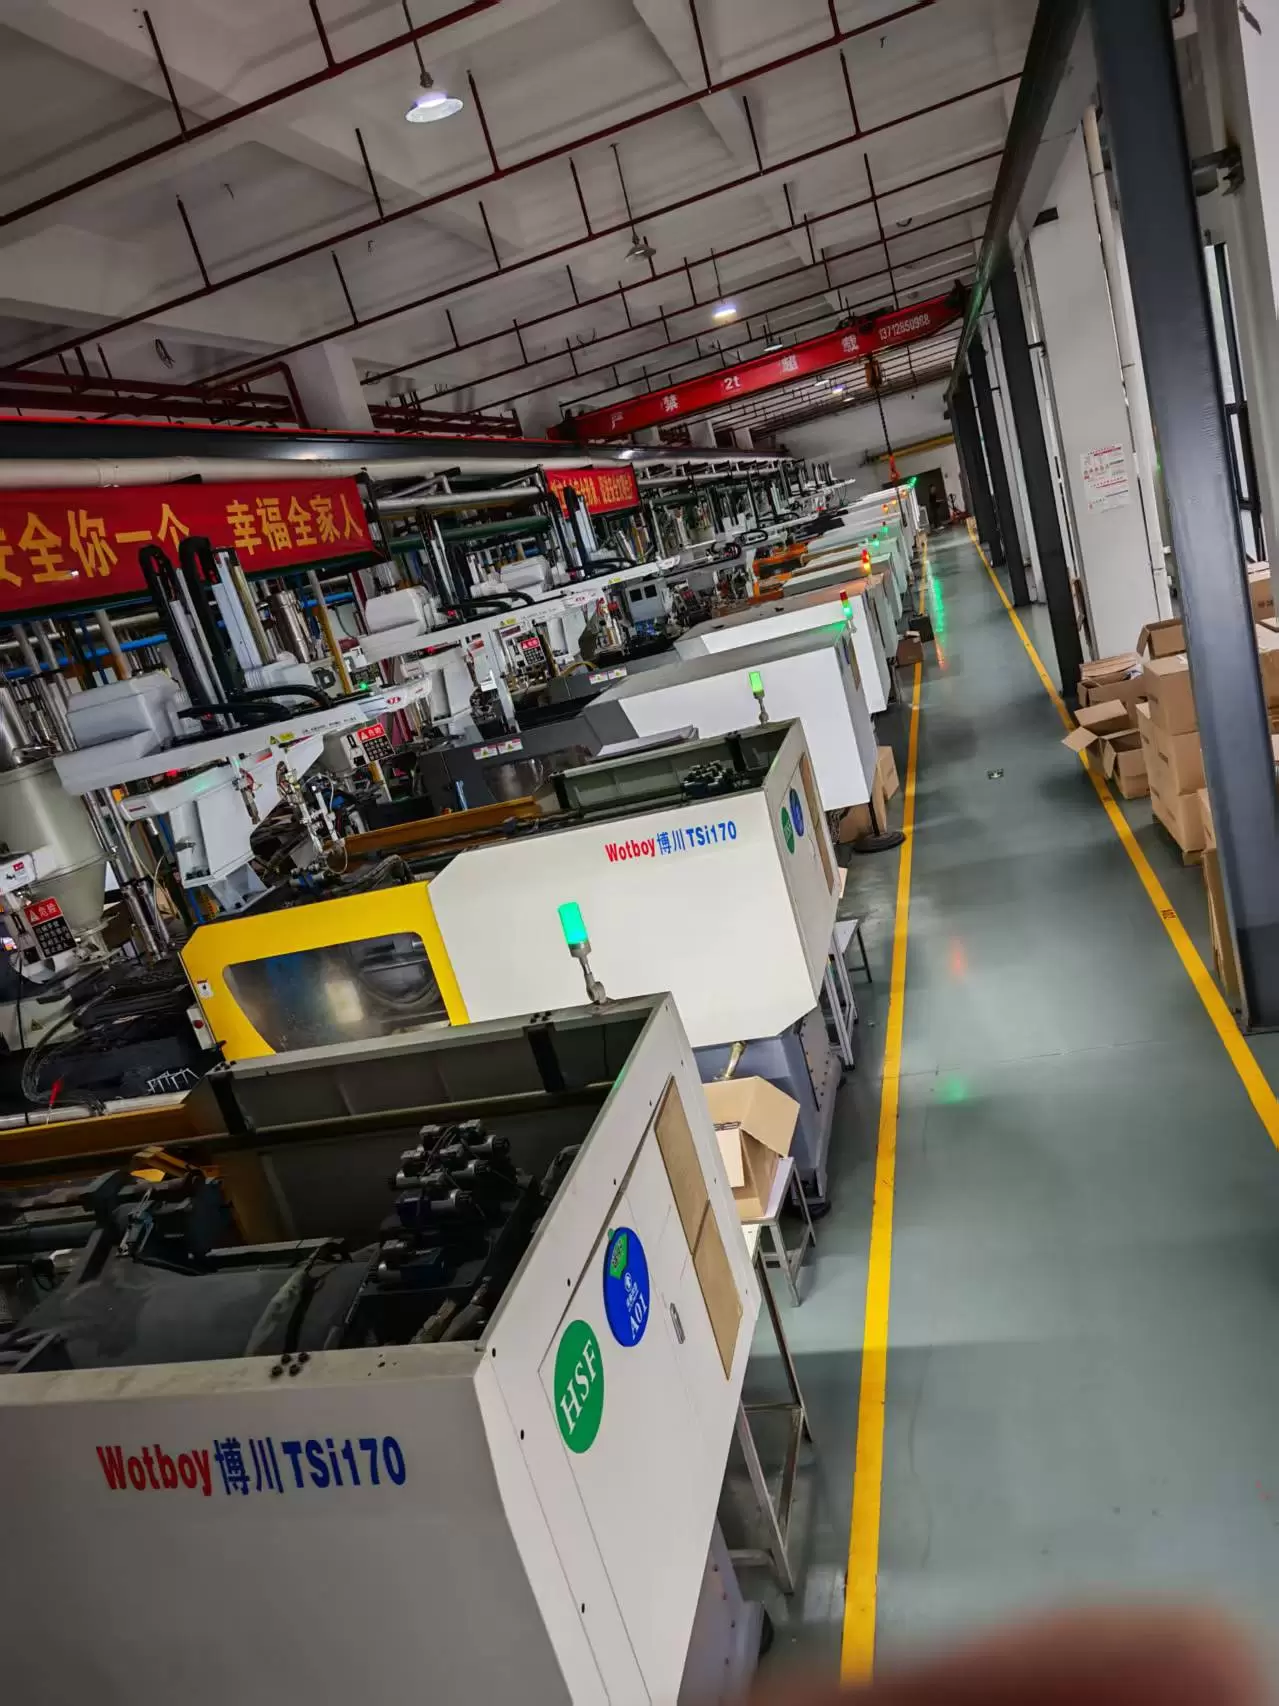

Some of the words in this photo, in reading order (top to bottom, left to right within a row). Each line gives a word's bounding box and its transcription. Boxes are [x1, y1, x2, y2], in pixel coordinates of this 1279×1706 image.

[724, 375, 741, 390] 2t
[226, 493, 364, 556] 幸福全家人
[605, 837, 656, 863] Wotboy
[656, 828, 686, 855] 博川
[686, 820, 737, 847] TSi170
[560, 1339, 597, 1435] HSF
[96, 1443, 212, 1497] Wotboy
[213, 1437, 284, 1496] 博川
[281, 1435, 407, 1489] TSi170
